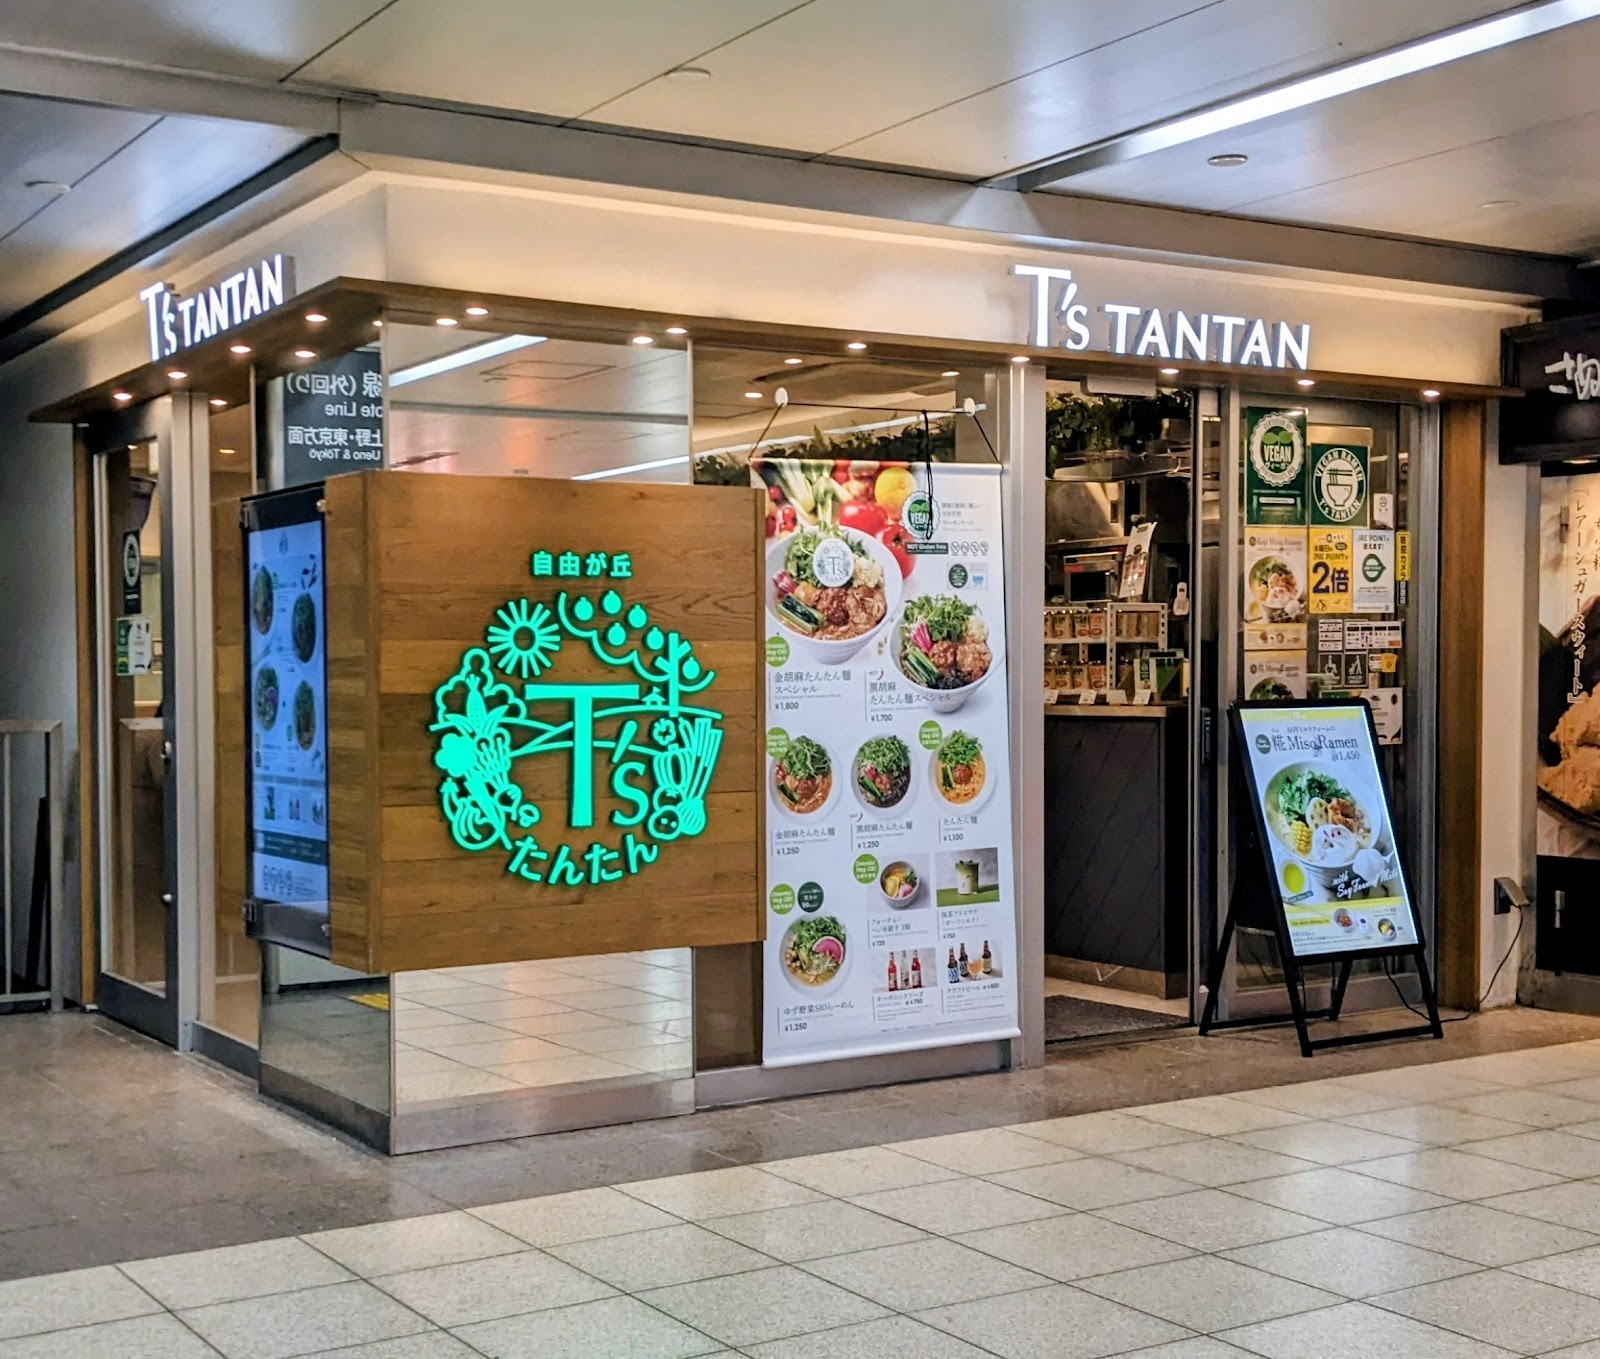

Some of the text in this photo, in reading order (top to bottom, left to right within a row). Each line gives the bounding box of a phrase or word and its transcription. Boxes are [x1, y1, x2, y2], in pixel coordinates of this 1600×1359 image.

[140, 254, 283, 361] T's TANTAN
[1014, 264, 1310, 370] T's TANTAN
[1263, 445, 1292, 462] VEGAN
[1316, 451, 1364, 481] VEGAN RAMEN
[1331, 499, 1361, 520] TANTAN
[532, 551, 631, 577] 自由が丘
[1312, 561, 1349, 594] 2倍
[775, 685, 817, 694] スペシャル
[869, 682, 896, 693] 黒胡麻
[525, 684, 649, 827] T's
[1288, 735, 1319, 750] Miso
[1317, 734, 1359, 749] Ramen
[508, 834, 658, 886] たんたん
